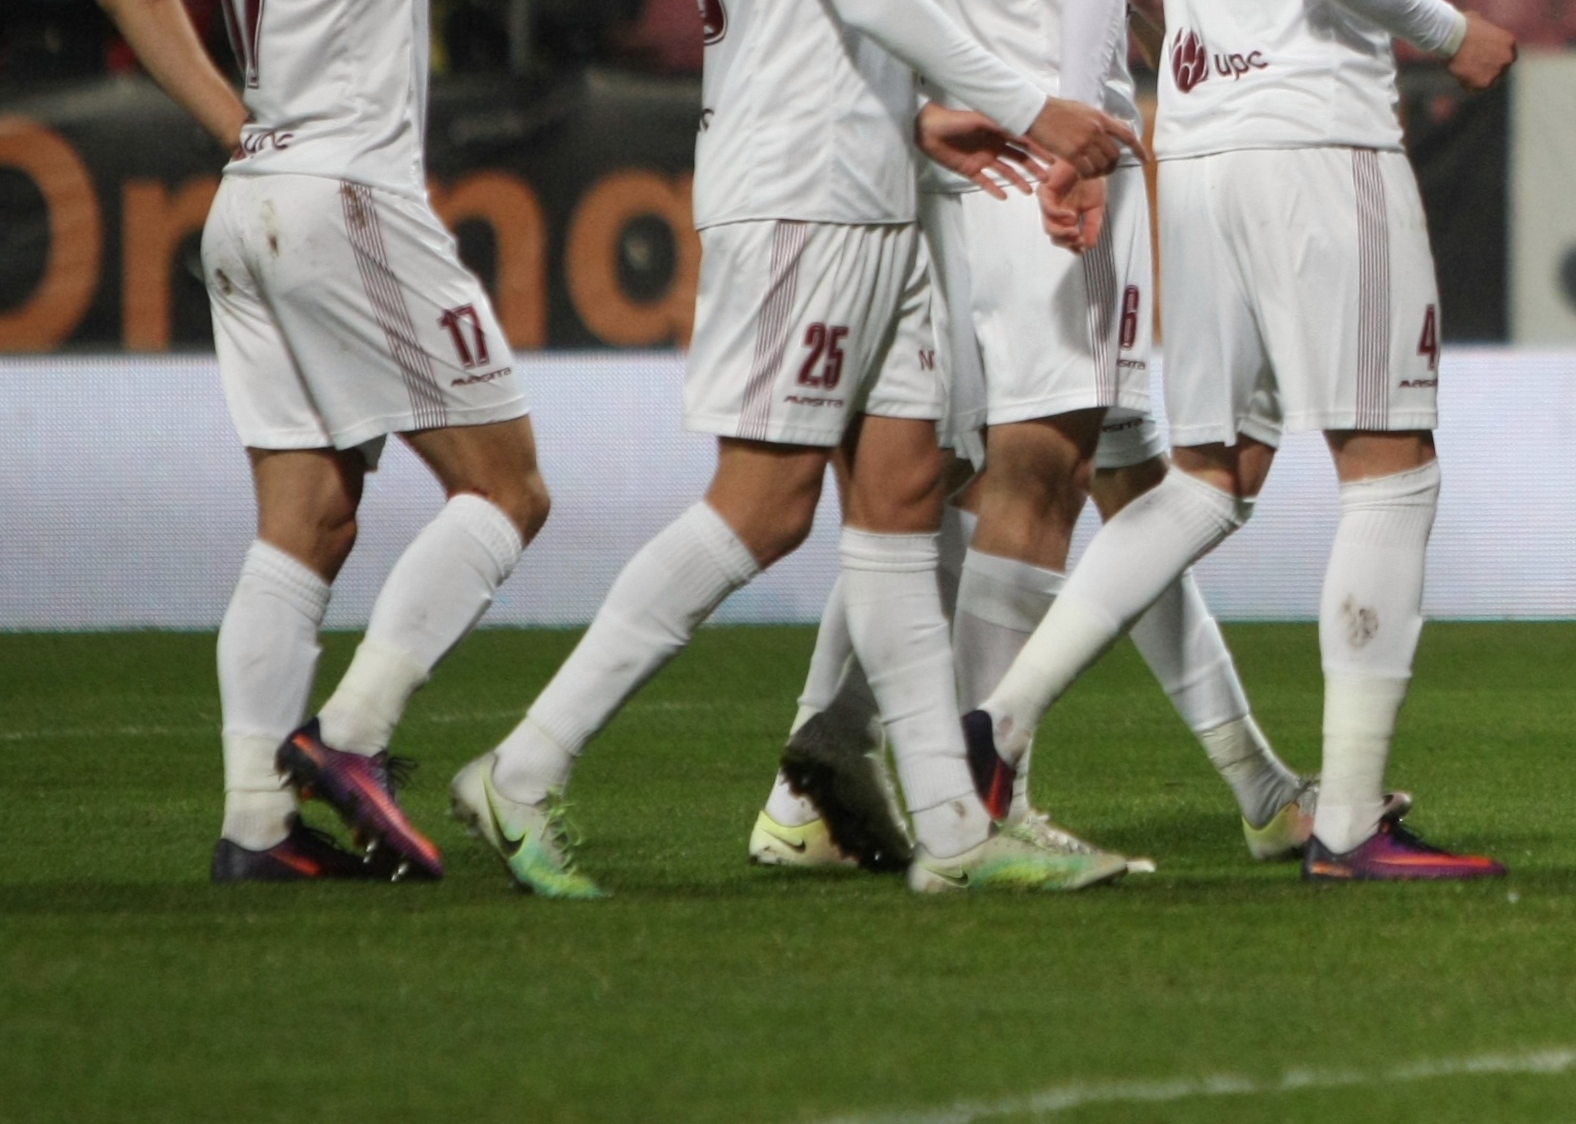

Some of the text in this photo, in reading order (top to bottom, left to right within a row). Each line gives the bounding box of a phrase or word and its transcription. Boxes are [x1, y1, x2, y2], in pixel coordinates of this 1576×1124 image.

[1213, 50, 1269, 82] upc
[437, 303, 490, 370] 17
[1119, 284, 1140, 351] 6
[1416, 303, 1438, 372] 4
[797, 321, 849, 392] 25
